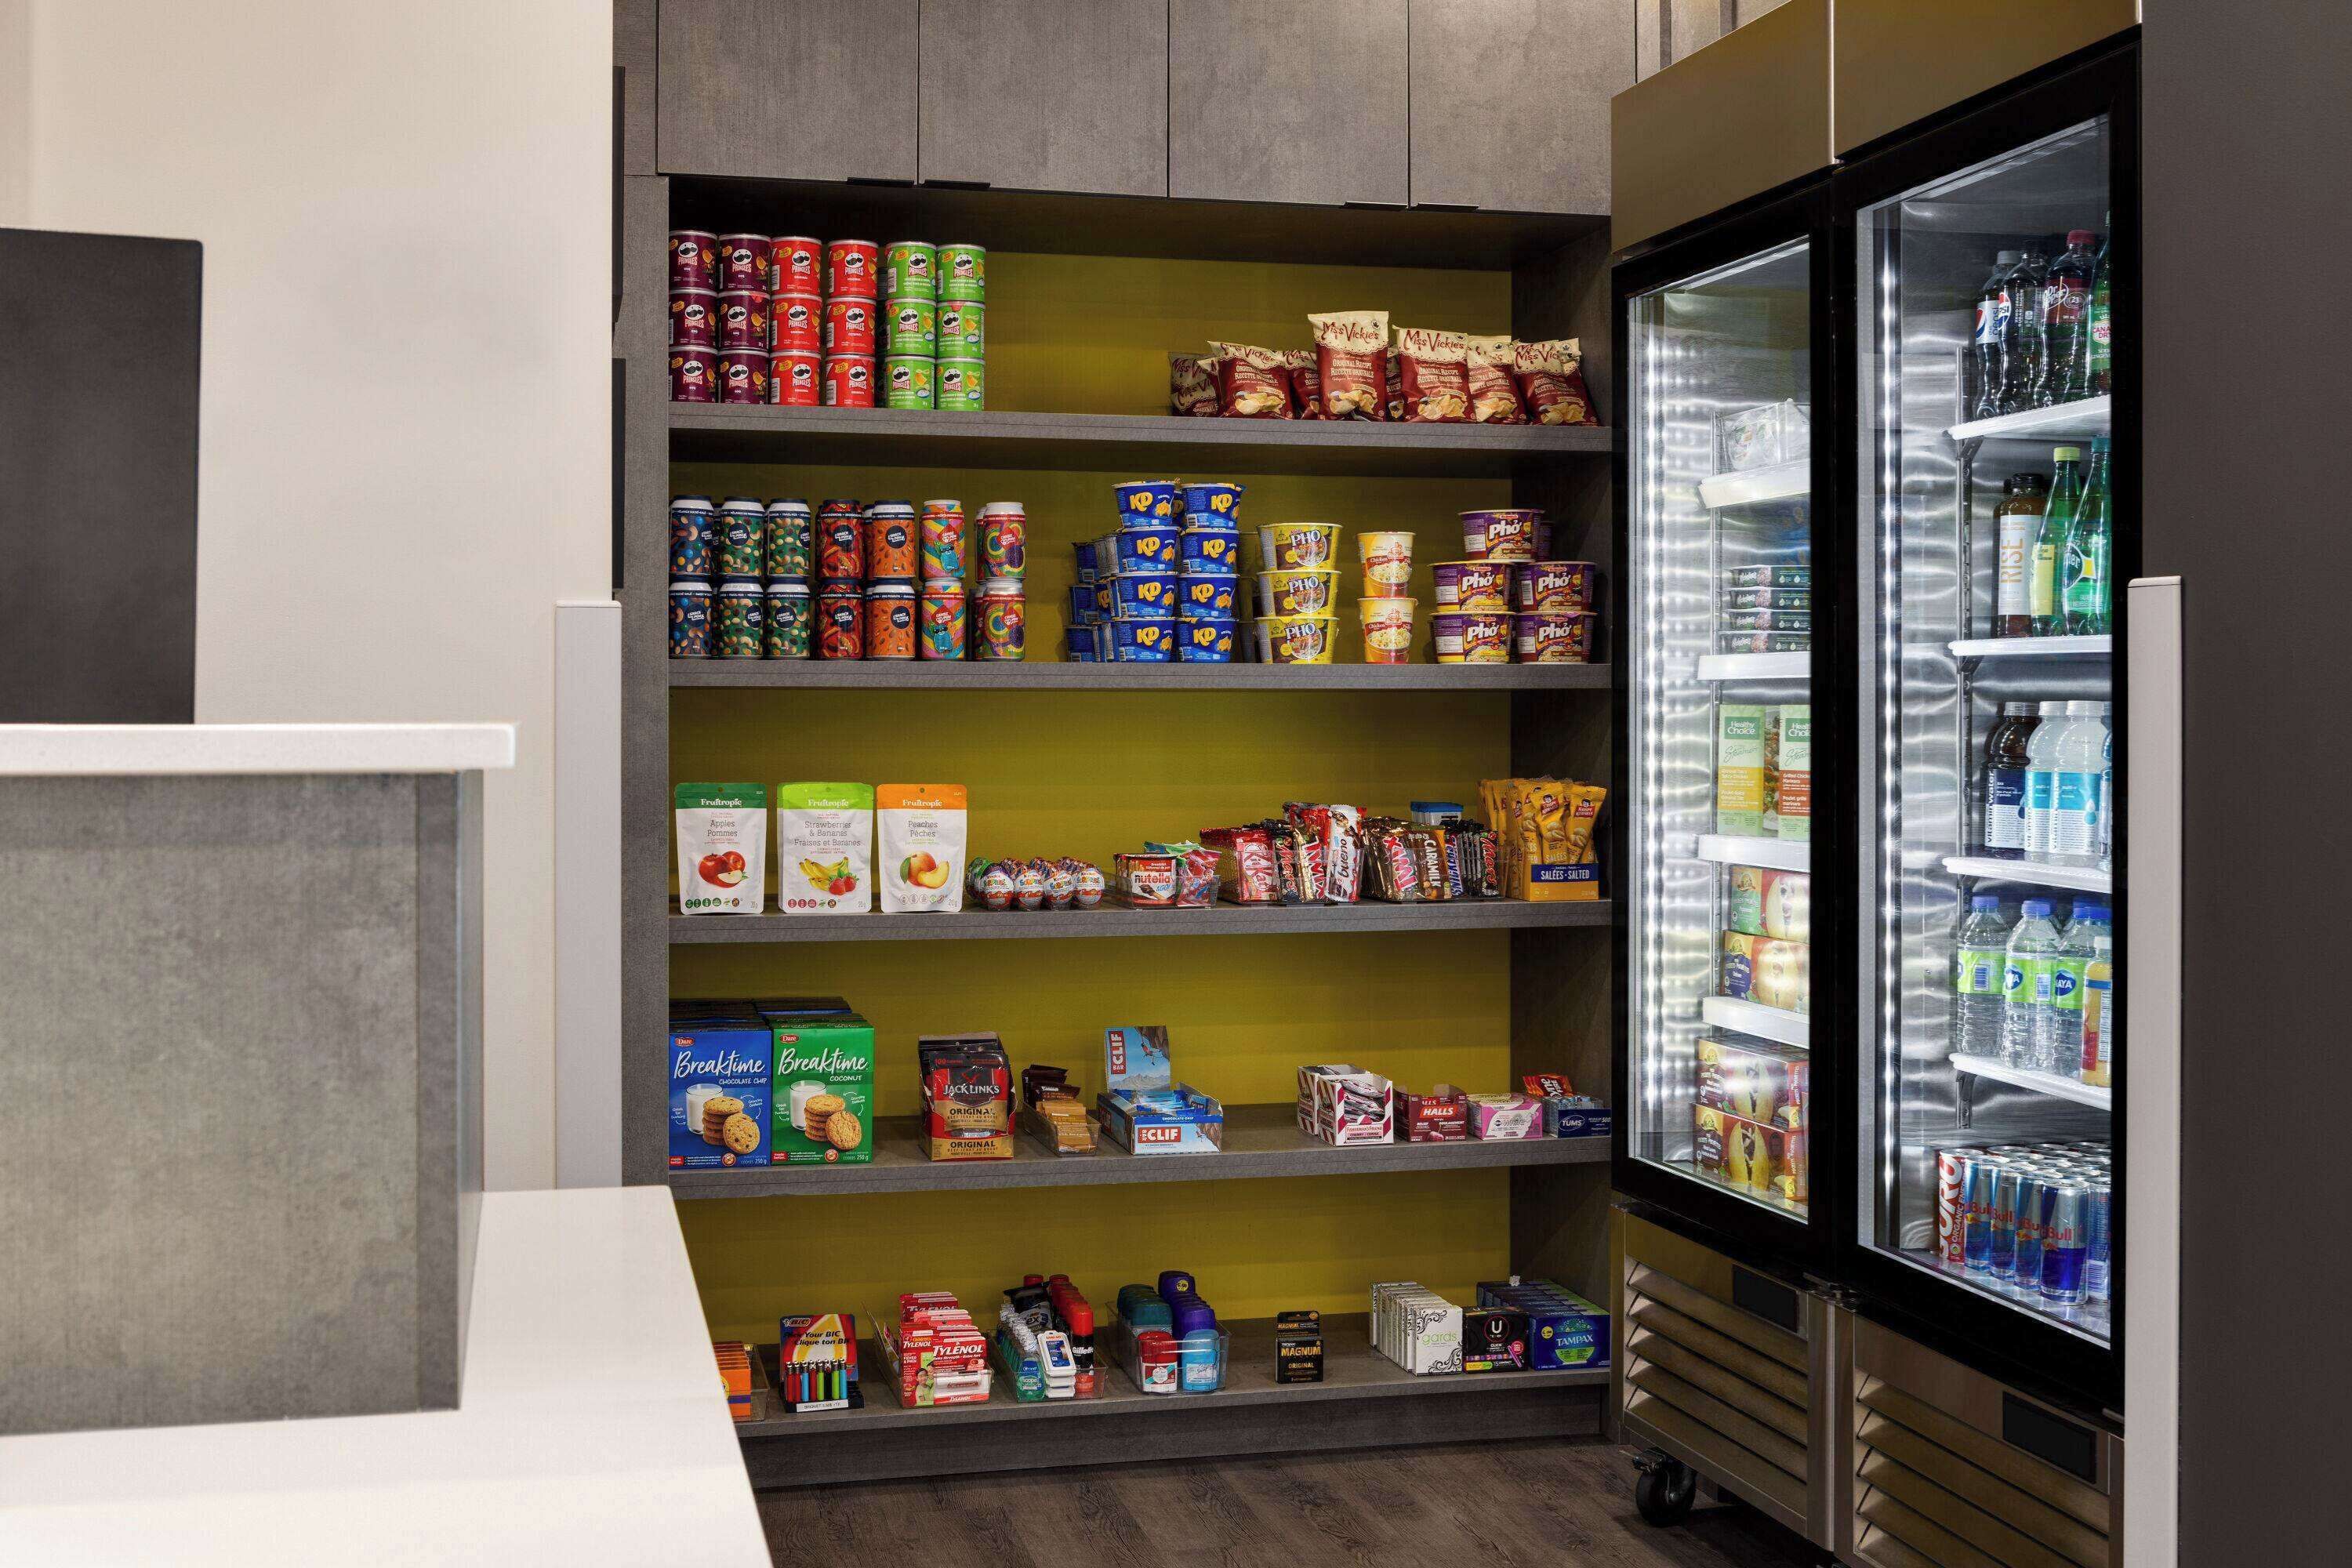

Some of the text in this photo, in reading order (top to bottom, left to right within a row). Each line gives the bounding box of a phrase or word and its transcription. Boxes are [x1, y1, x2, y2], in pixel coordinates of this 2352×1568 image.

[678, 257, 698, 266] PRINGLES
[732, 263, 752, 273] PRINGLES
[792, 265, 811, 274] PRINGLES
[844, 267, 864, 276] PRINGLES
[909, 267, 927, 276] PRINGLES
[953, 268, 973, 278] PRINGLES
[684, 320, 704, 328] PRINGLES
[728, 321, 746, 330] PRINGLES
[788, 320, 808, 329] PRINGLES
[845, 322, 865, 331] PRINGLES
[898, 323, 918, 332] PRINGLES
[942, 326, 960, 335] PRINGLES
[1343, 322, 1379, 343] Vickie's
[1403, 329, 1465, 353] Miss Vickie's
[1419, 367, 1441, 376] ORIGINAL
[684, 376, 702, 385] PRINGLES
[729, 379, 748, 388] PRINGLES
[792, 378, 811, 387] PRINGLES
[848, 379, 867, 389] PRINGLES
[892, 381, 909, 390] PRINGLES
[943, 383, 962, 392] PRINGLES
[1130, 492, 1153, 512] KD
[1210, 494, 1233, 513] KD
[1290, 529, 1321, 546] PHO
[1137, 536, 1160, 557] KD
[1203, 539, 1225, 558] KD
[2000, 538, 2024, 583] RISE
[1287, 576, 1319, 593] PHO
[1138, 582, 1162, 602] KD
[1192, 583, 1214, 603] KD
[1137, 627, 1160, 646] KD
[1193, 627, 1217, 646] KD
[1284, 622, 1316, 640] PHO
[701, 798, 742, 808] Fruitropic
[808, 798, 848, 808] Fruitropic
[903, 799, 942, 808] Fruitropic
[1338, 838, 1348, 878] bueno
[1383, 836, 1417, 891] TWIX
[1424, 840, 1441, 887] CARAMILK
[1480, 837, 1497, 886] Mars
[1305, 836, 1327, 899] TWIX
[1134, 873, 1171, 884] nutella
[1541, 869, 1590, 880] SALÉES SALTED
[1110, 1033, 1123, 1065] CLIF
[673, 1049, 765, 1079] Breaktime
[778, 1047, 868, 1076] Breaktime
[943, 1084, 1000, 1094] JACK LINK'S
[1424, 1107, 1454, 1116] HALLS
[1147, 1129, 1178, 1141] CLIF
[1952, 1203, 1964, 1243] ORGANIC
[2049, 1226, 2073, 1240] Bull
[1491, 1320, 1502, 1333] U
[1556, 1334, 1593, 1347] TAMPAX
[933, 1345, 983, 1357] TYLENOL
[1281, 1347, 1321, 1356] MAGNUM
